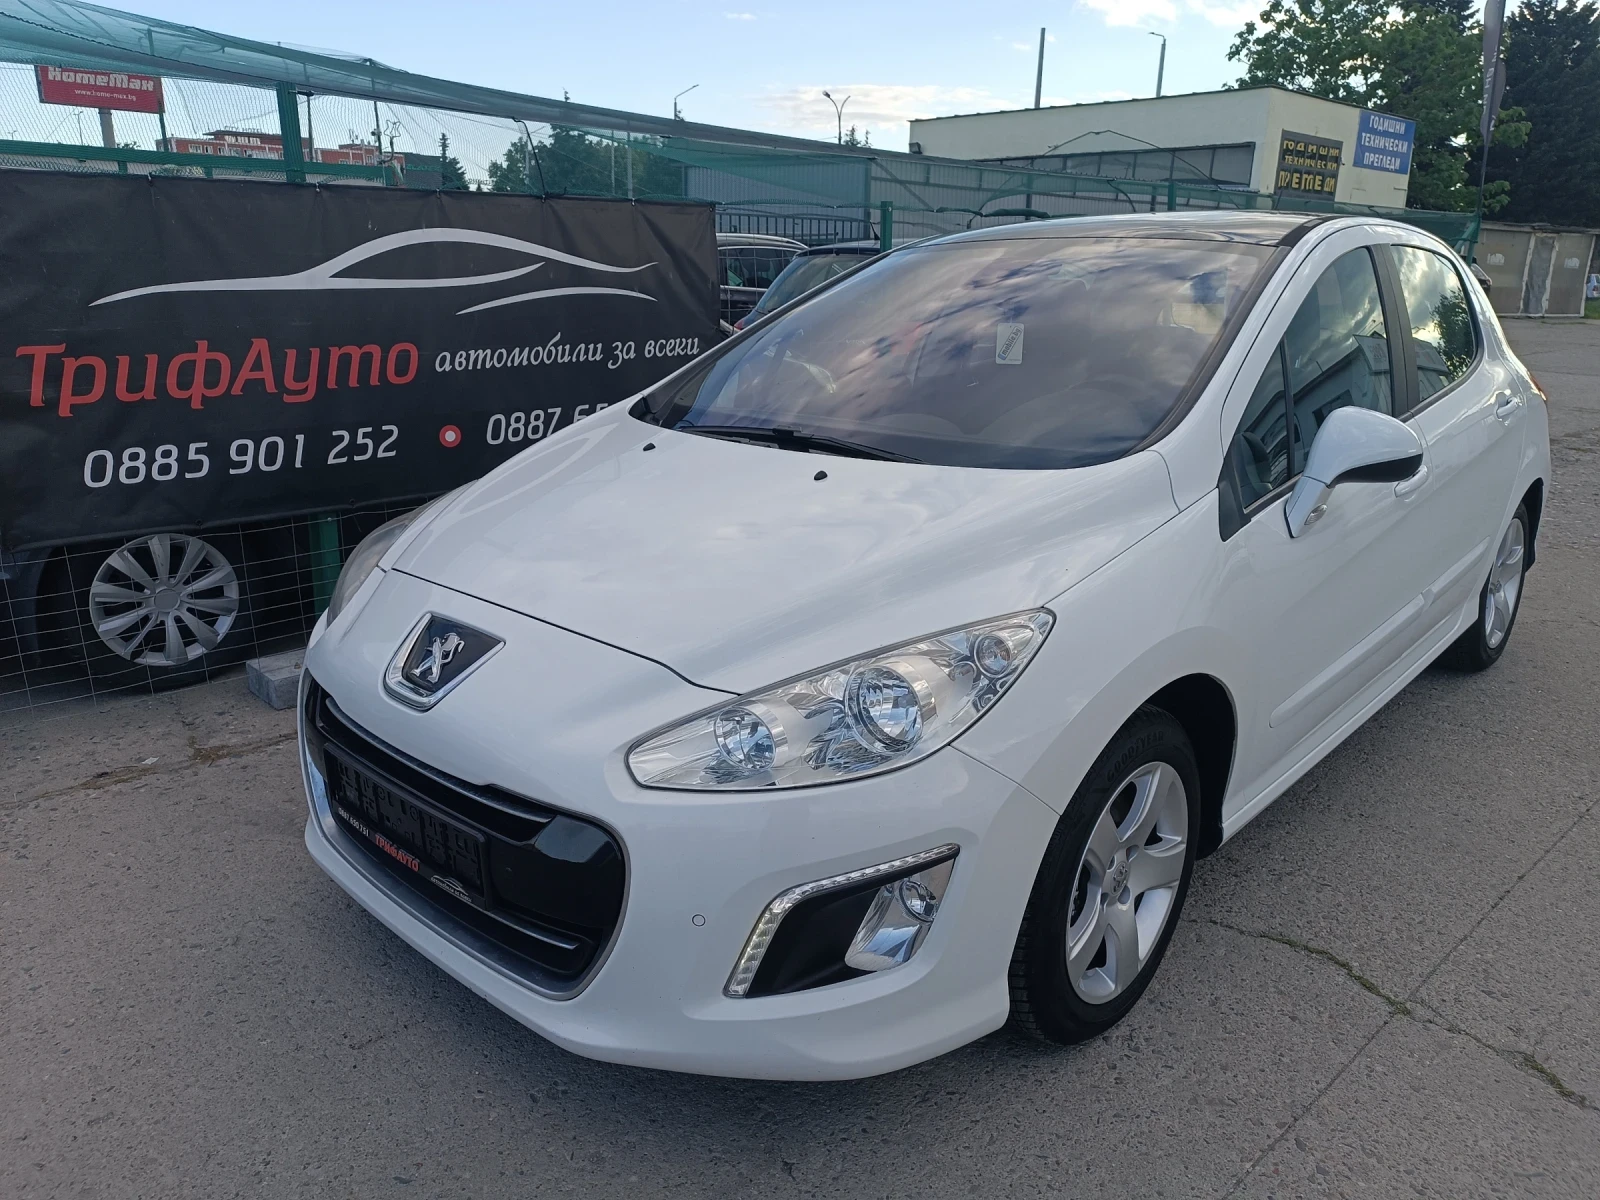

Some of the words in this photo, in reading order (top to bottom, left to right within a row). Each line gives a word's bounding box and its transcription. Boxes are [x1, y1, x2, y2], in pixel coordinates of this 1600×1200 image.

[1361, 132, 1408, 153] ТЕХНИЧЕСКИ
[1369, 115, 1406, 135] ГОДИШНИ
[1283, 140, 1340, 157] ГОДИШНИ
[1285, 155, 1338, 171] ТЕХНИЧЕСКИ
[1363, 152, 1401, 171] ПРЕГЛЕДИ
[435, 331, 603, 372] автомобили
[608, 341, 636, 369] за
[644, 337, 700, 358] всеки
[15, 337, 419, 417] ТрифАуто
[486, 407, 562, 445] 0887
[83, 441, 210, 488] 0885
[229, 434, 306, 475] 901
[326, 424, 399, 465] 252
[1106, 730, 1164, 783] GOODYEAR
[375, 833, 420, 872] ТРИФАУТО
